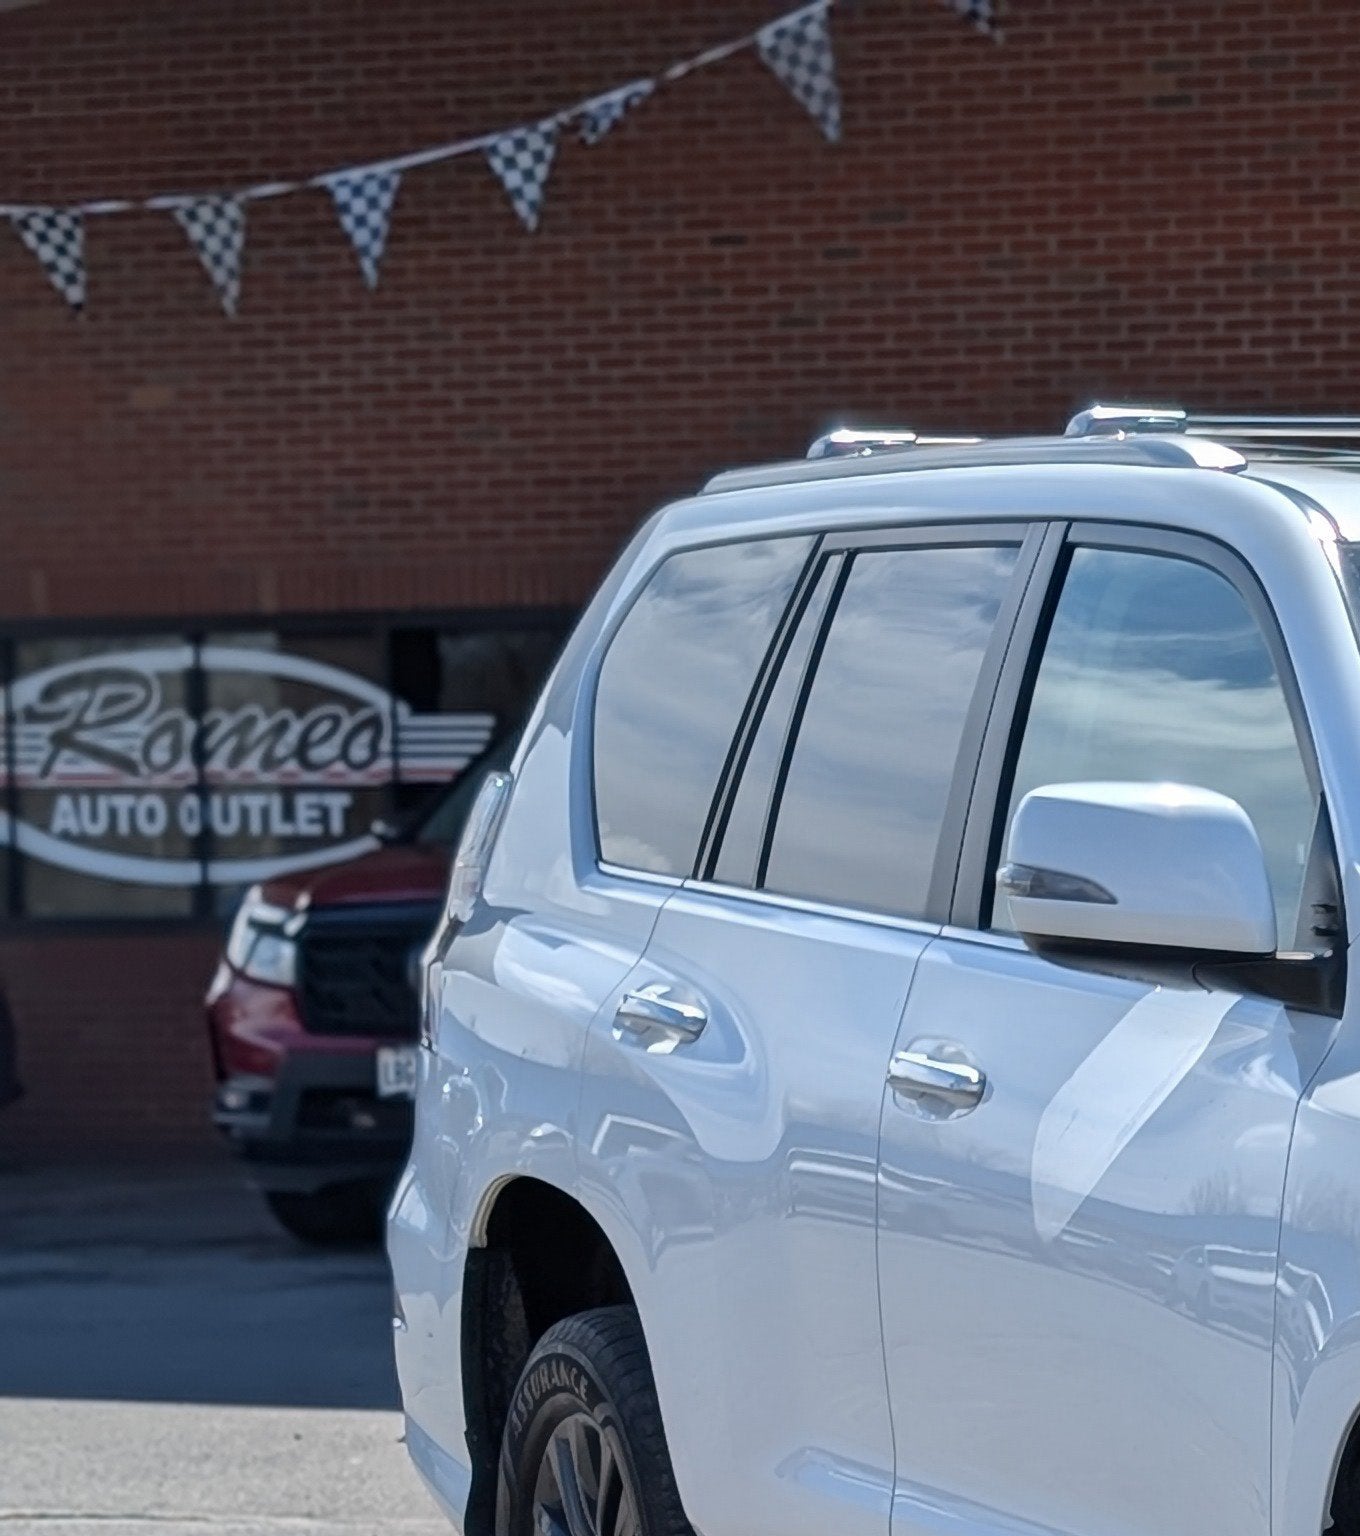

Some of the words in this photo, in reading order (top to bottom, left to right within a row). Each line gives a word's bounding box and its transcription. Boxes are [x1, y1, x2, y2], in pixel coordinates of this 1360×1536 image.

[22, 666, 390, 780] Romeo
[51, 792, 168, 839] AUTO
[178, 790, 353, 838] OUTLET
